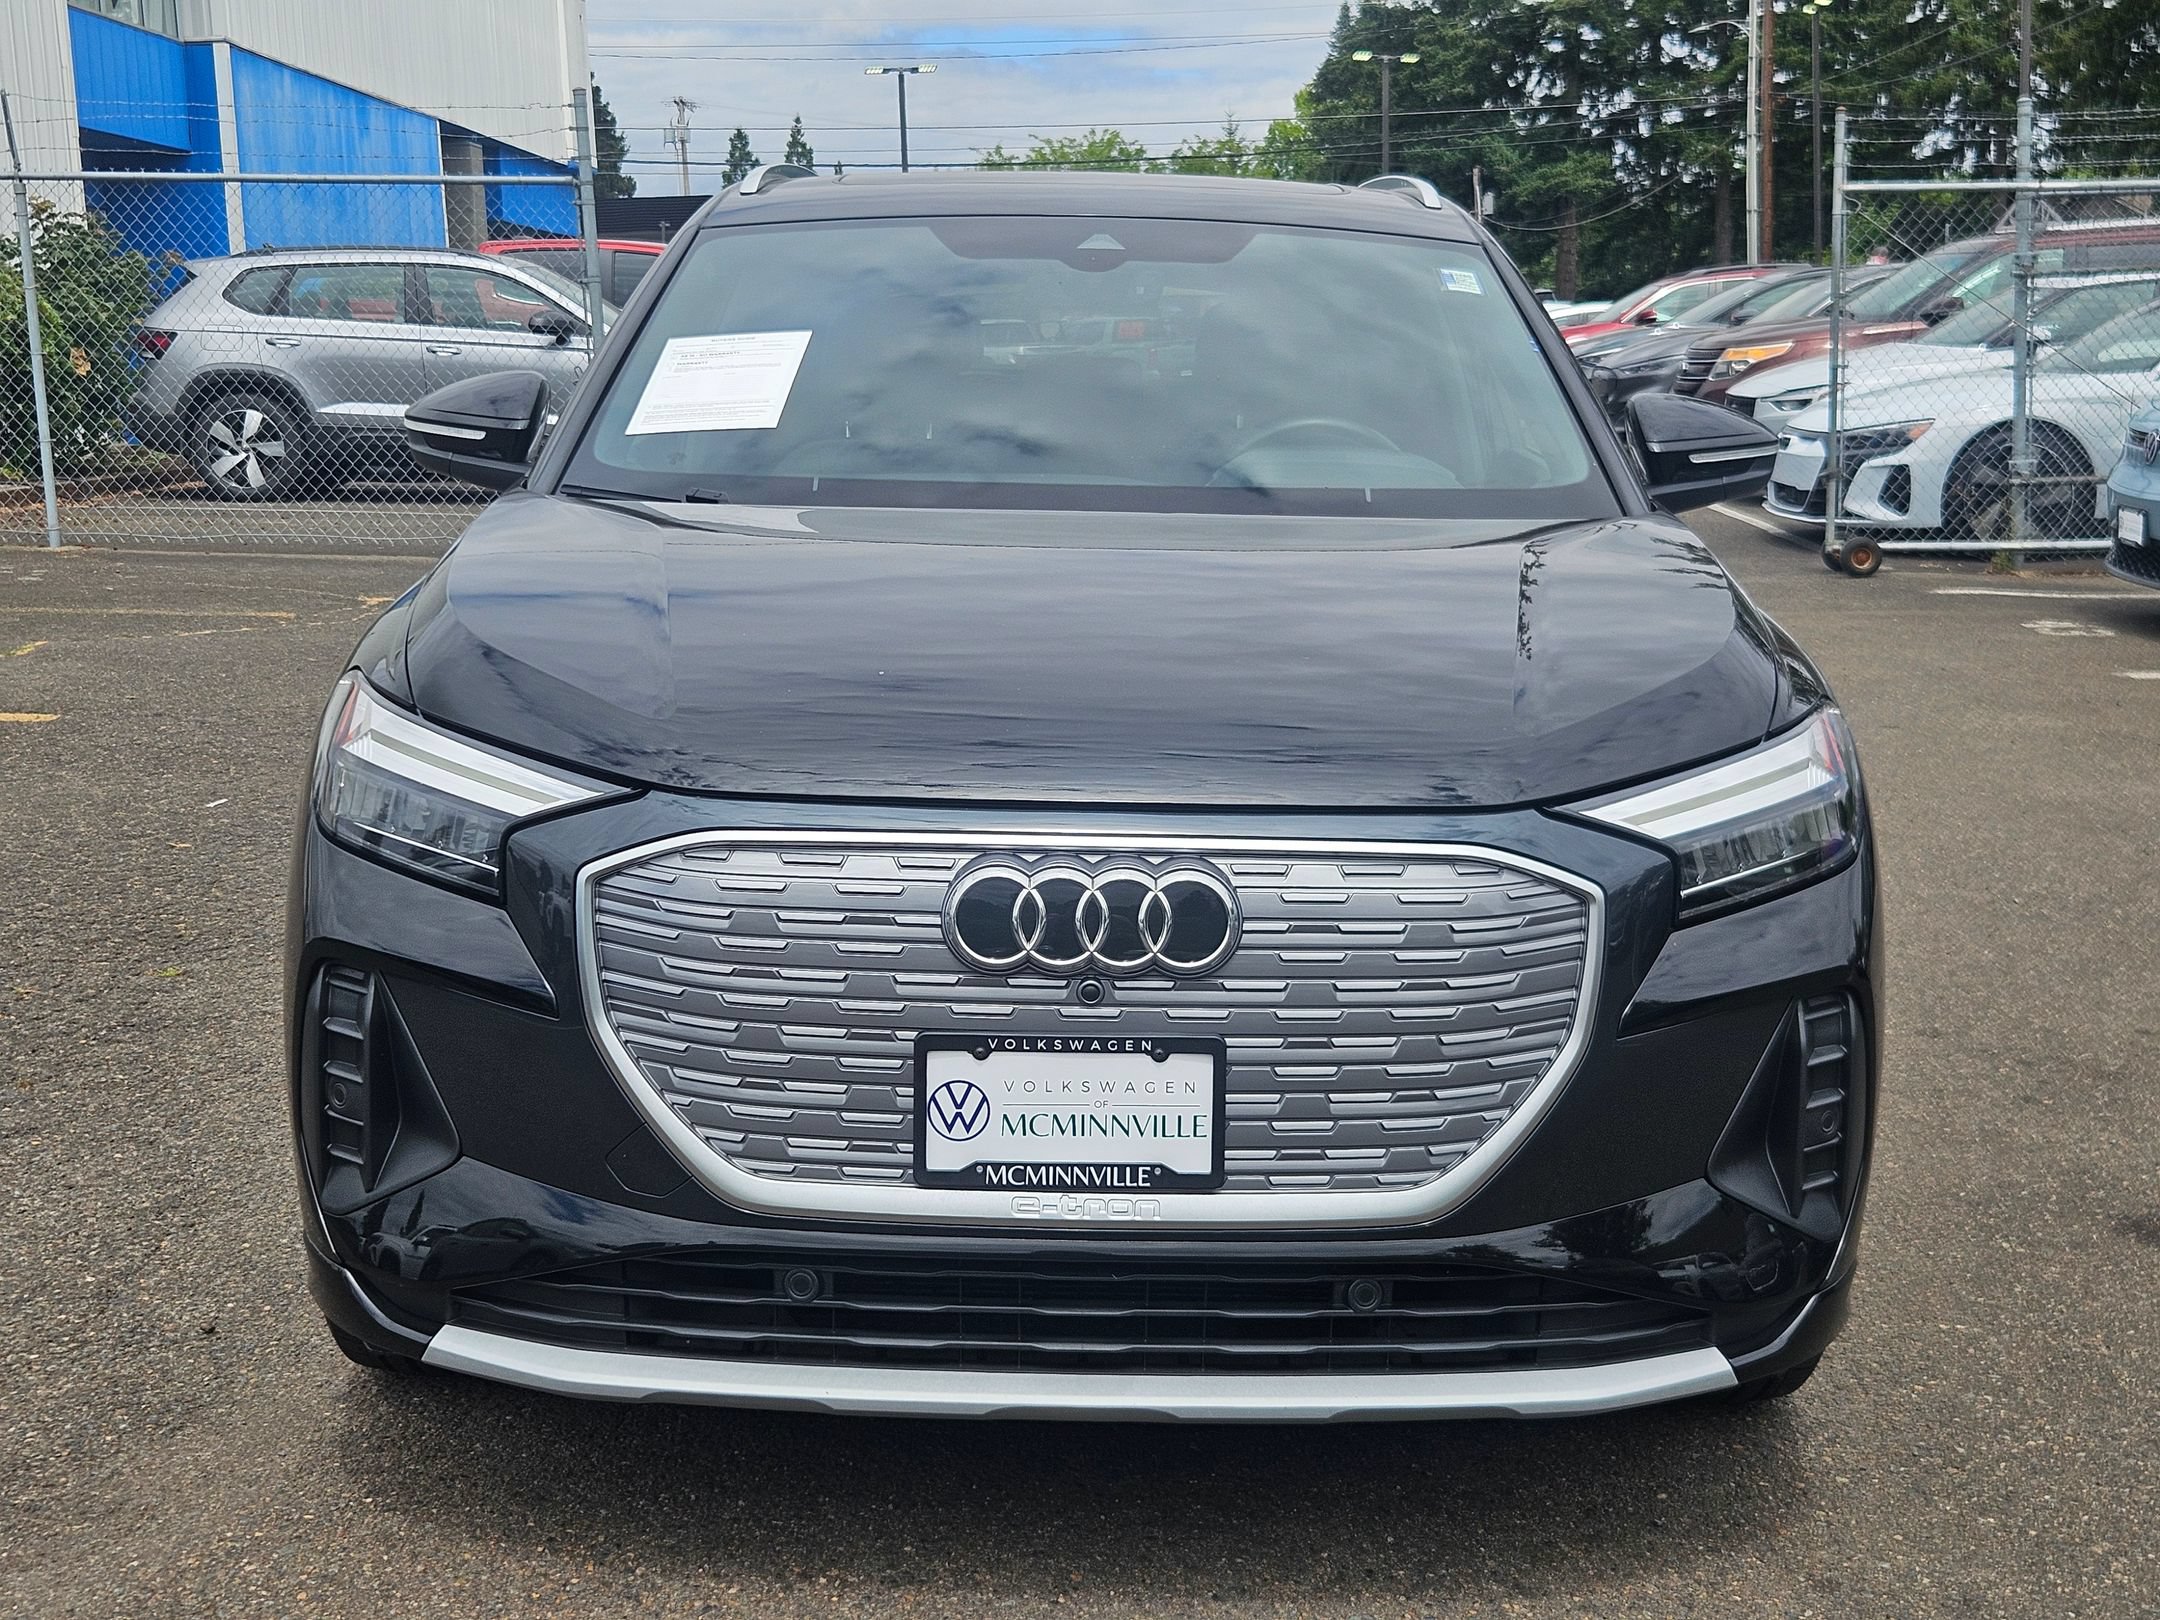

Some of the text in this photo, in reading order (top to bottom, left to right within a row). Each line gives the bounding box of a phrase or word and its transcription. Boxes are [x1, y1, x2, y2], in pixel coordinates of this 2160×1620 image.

[987, 1038, 1153, 1051] VOLKSWAGEN
[1003, 1080, 1197, 1094] VOLKSWAGEN
[1093, 1100, 1109, 1109] OF
[1001, 1113, 1208, 1138] MCMINNVILLE
[985, 1164, 1151, 1188] MCMINNVILLE
[1010, 1194, 1161, 1220] e-tron
